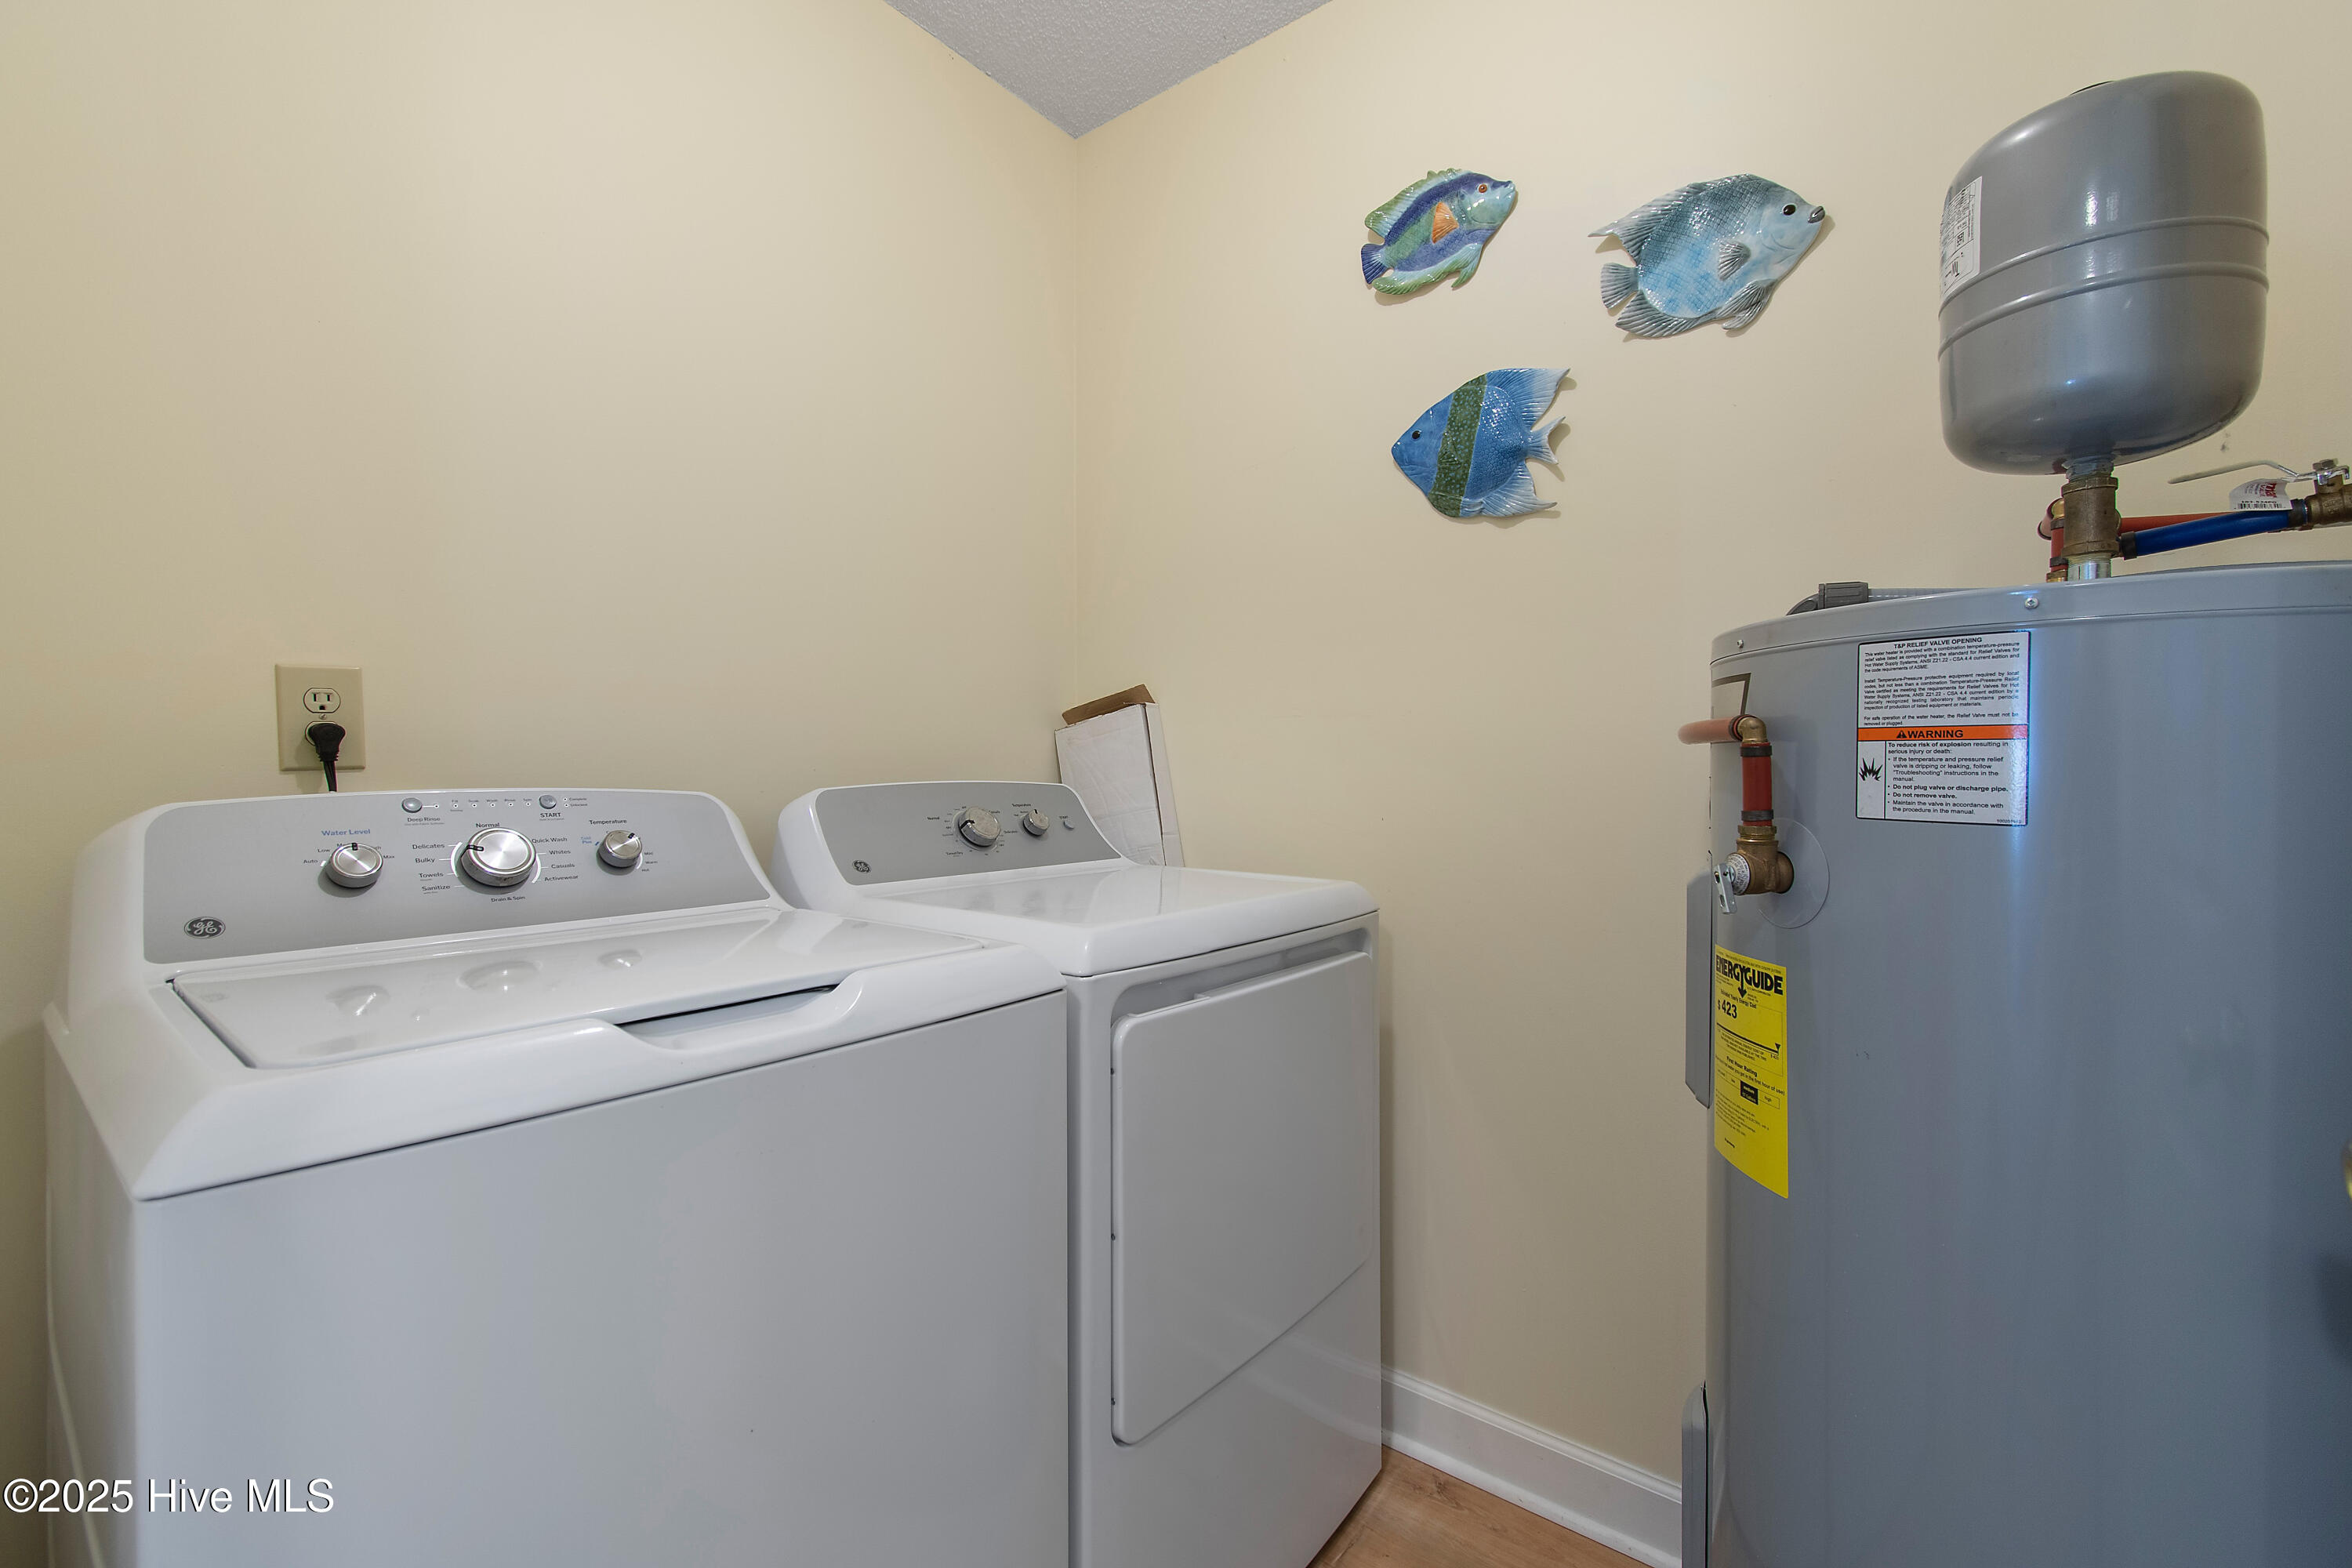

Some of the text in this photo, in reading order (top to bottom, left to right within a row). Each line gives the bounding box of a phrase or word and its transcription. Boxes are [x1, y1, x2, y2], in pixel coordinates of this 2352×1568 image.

[1907, 730, 1963, 739] WARNING
[1716, 955, 1783, 996] ENERGYGUIDE
[1722, 1000, 1737, 1018] 423
[1744, 1065, 1757, 1077] Rating
